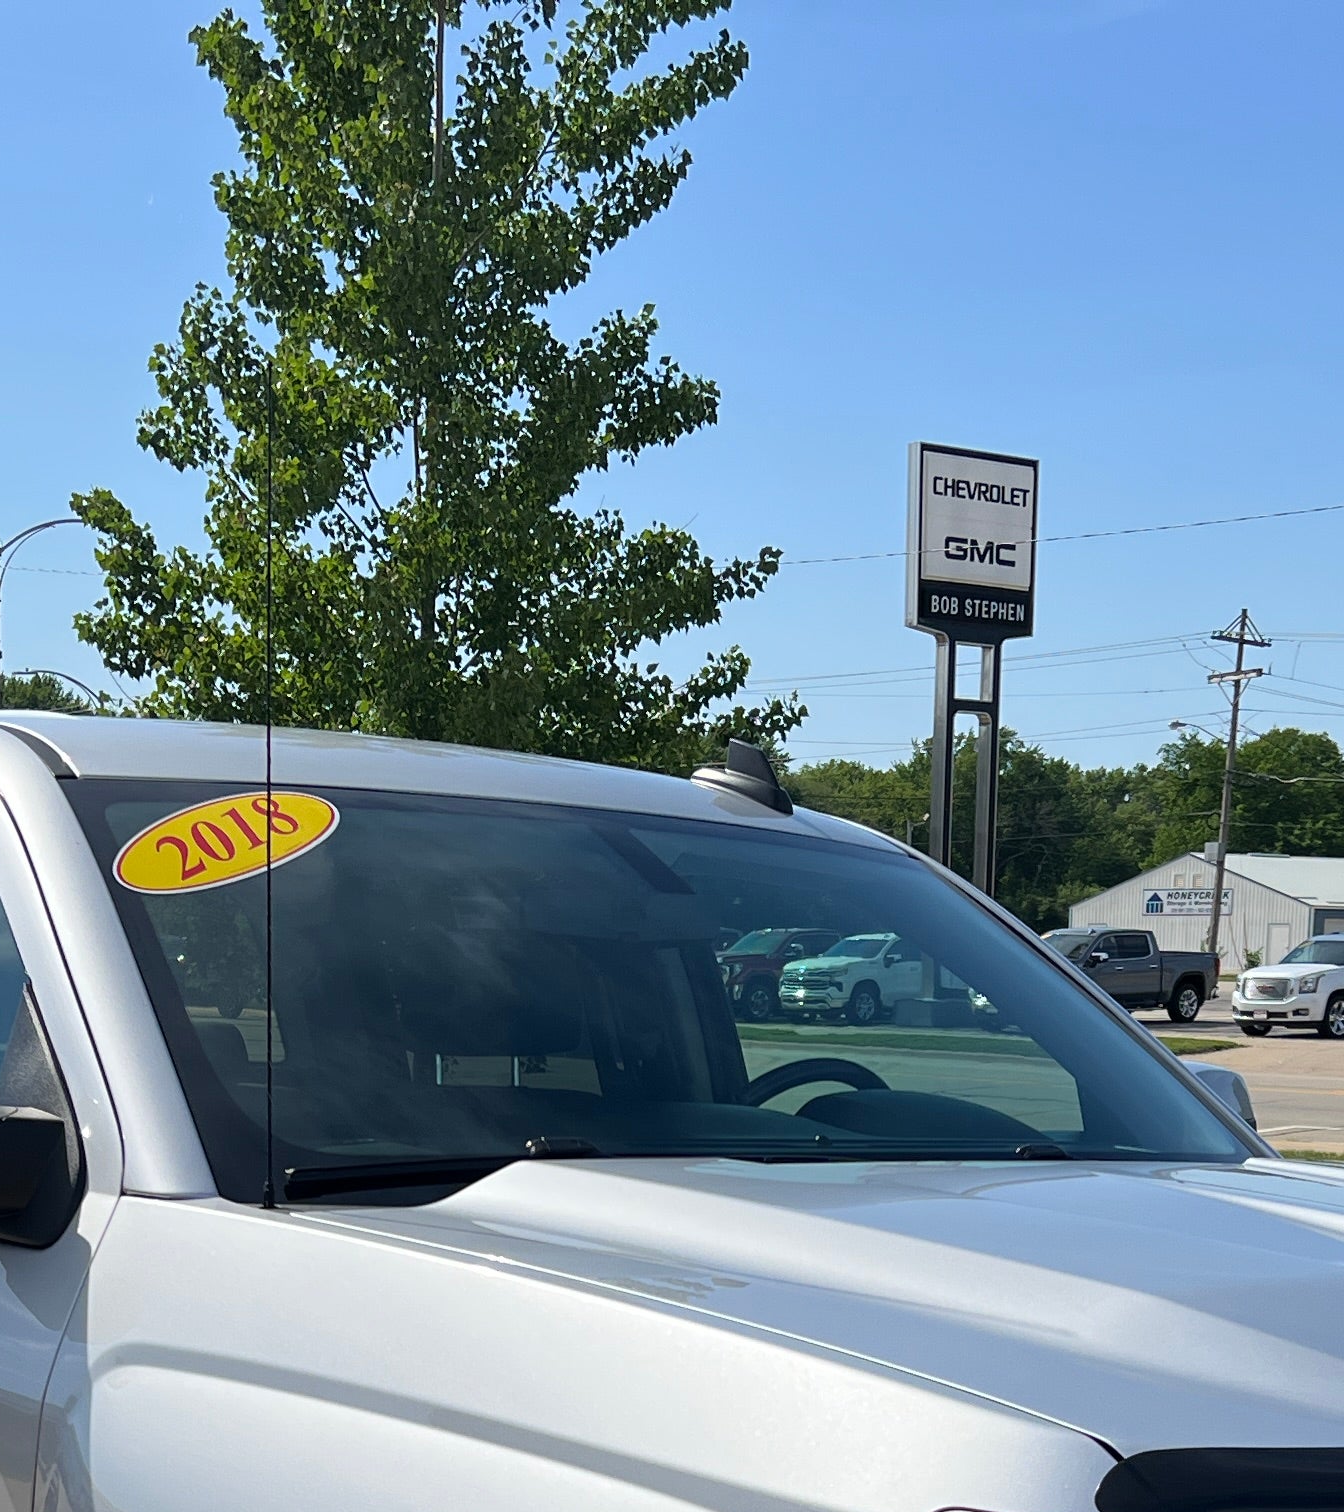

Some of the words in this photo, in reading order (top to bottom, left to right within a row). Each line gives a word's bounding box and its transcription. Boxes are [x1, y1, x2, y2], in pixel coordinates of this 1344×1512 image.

[932, 475, 1031, 508] CHEVROLET
[944, 535, 1017, 568] GMC
[930, 594, 959, 615] BOB
[964, 599, 1026, 623] STEPHEN
[155, 796, 300, 882] 2018
[1166, 891, 1230, 900] HONEYCRK
